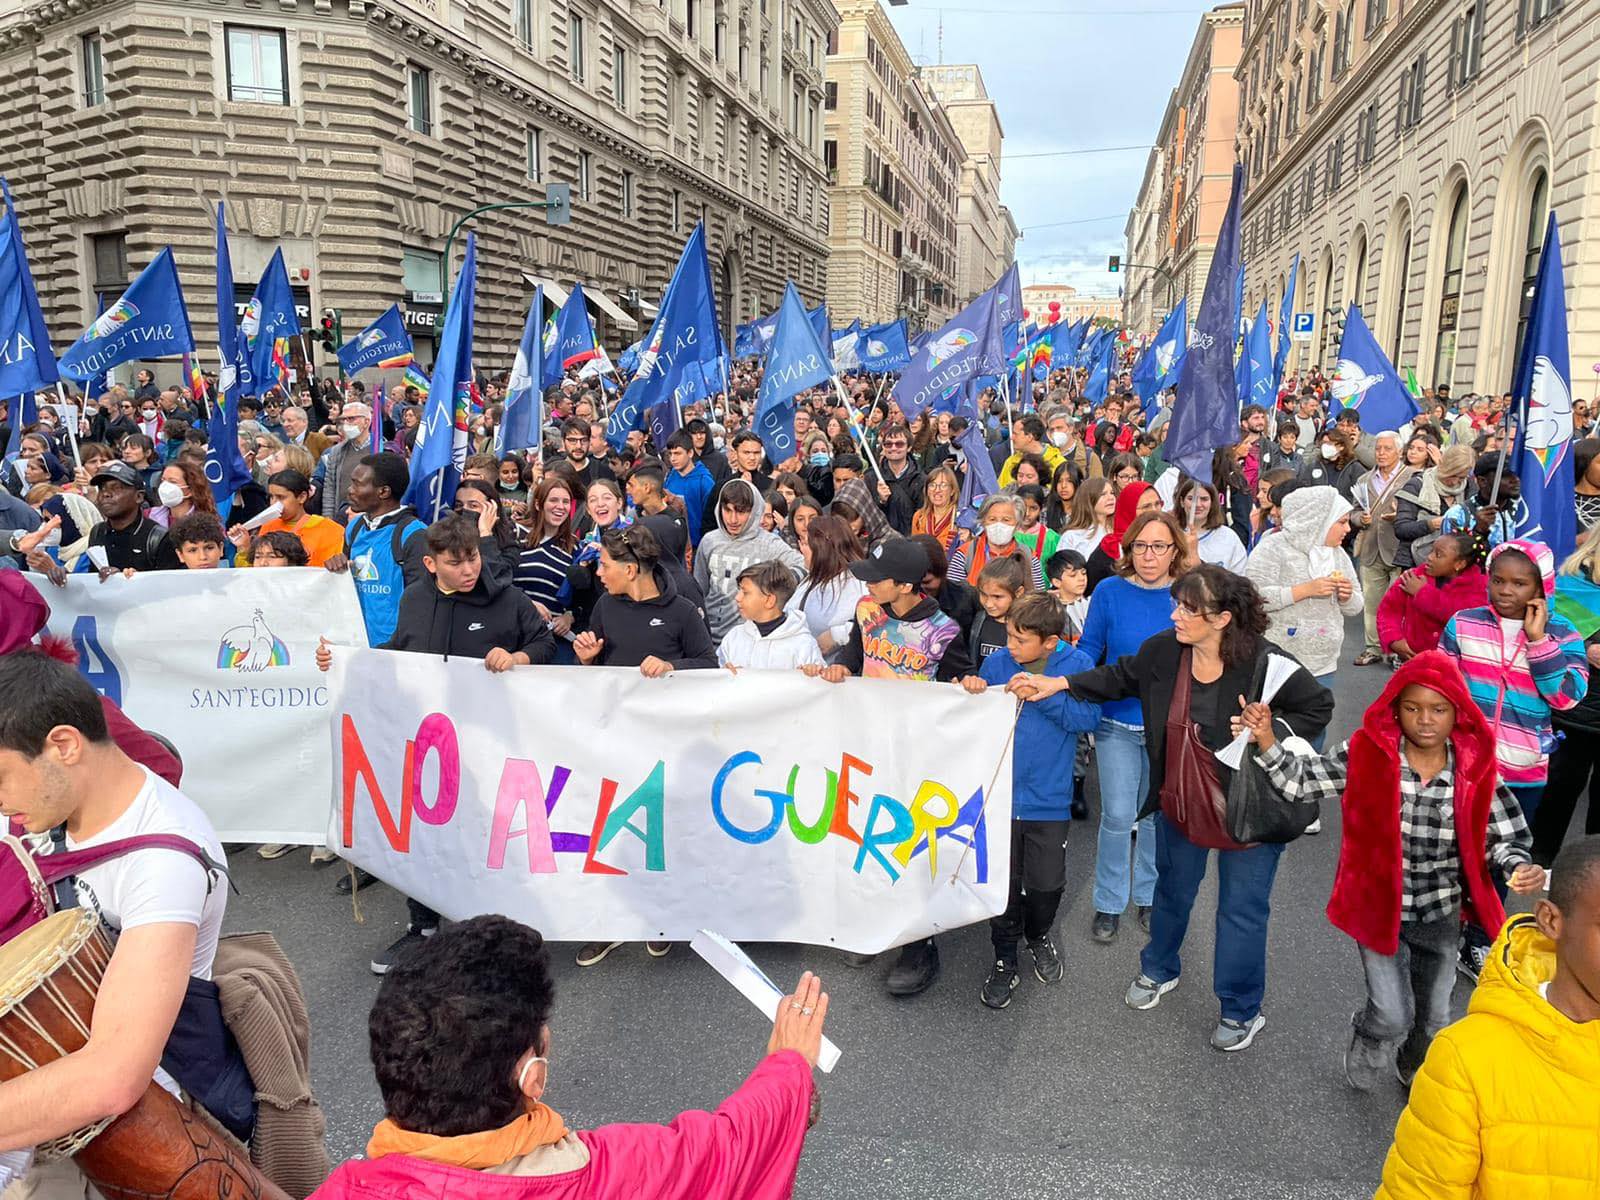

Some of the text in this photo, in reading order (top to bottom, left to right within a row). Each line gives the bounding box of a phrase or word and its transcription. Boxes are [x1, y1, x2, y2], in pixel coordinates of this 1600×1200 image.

[405, 310, 438, 326] TIGE
[1297, 315, 1310, 331] P
[342, 712, 988, 887] NO ALLA GUERRA
